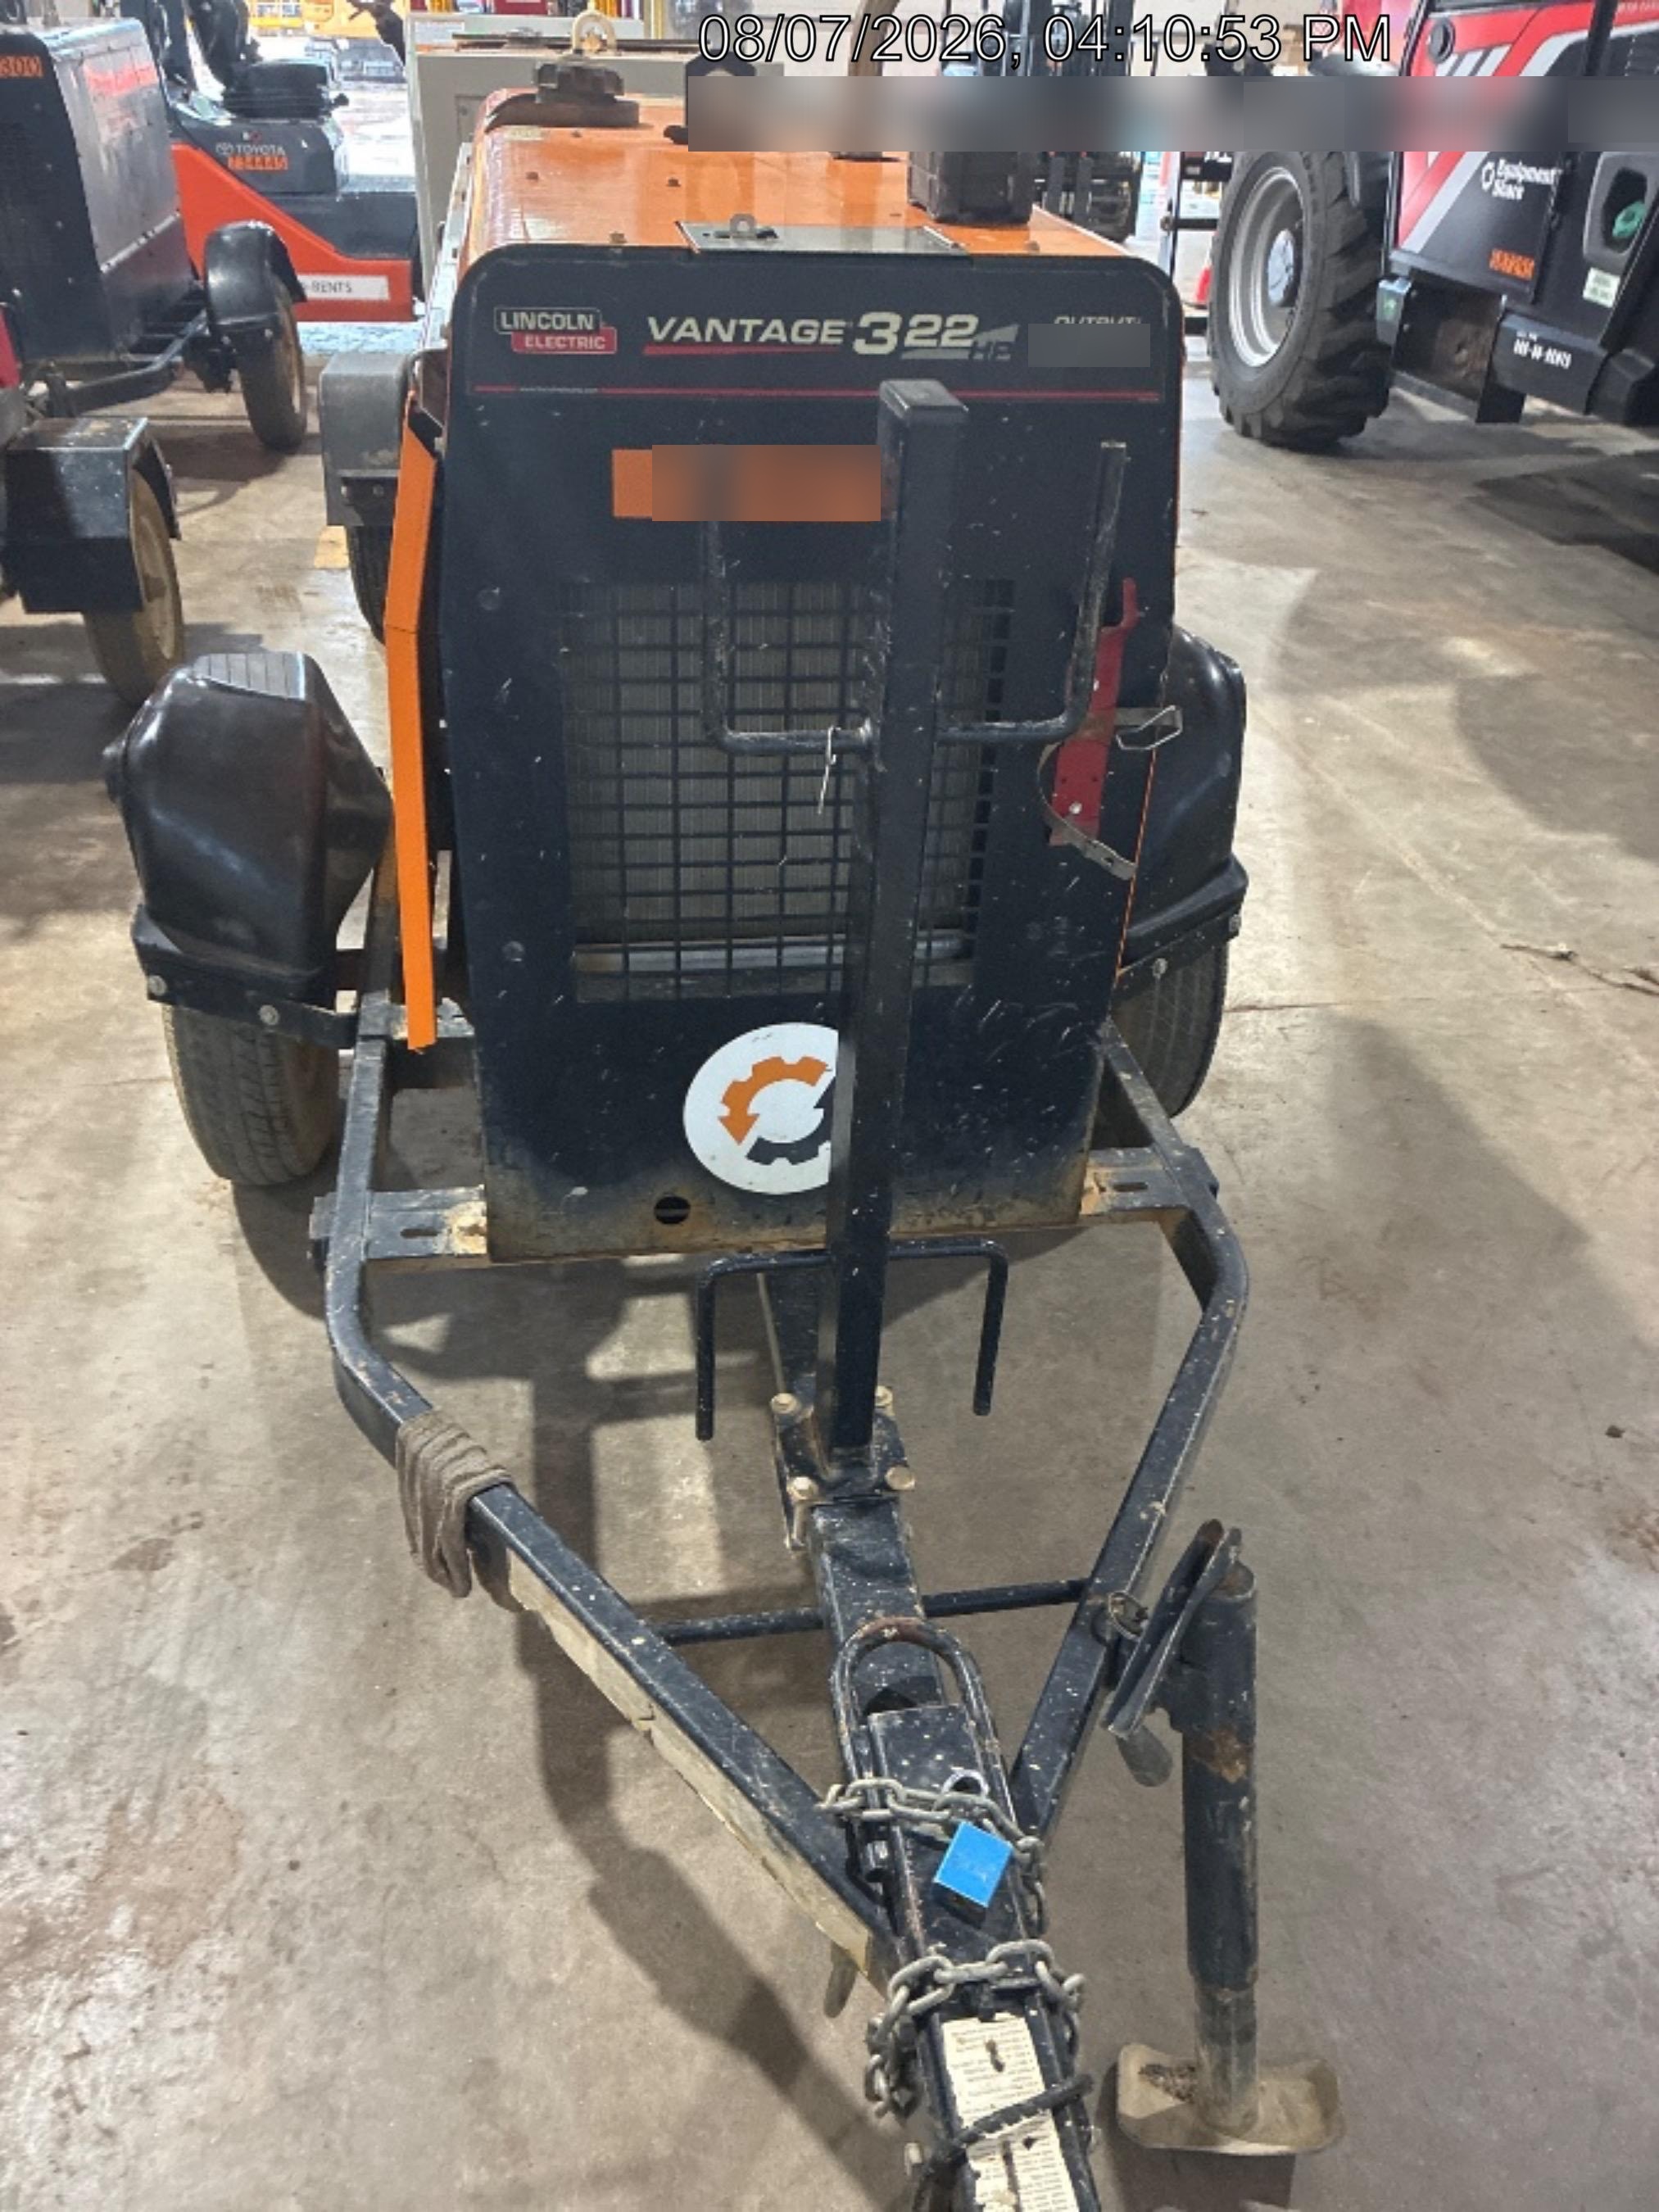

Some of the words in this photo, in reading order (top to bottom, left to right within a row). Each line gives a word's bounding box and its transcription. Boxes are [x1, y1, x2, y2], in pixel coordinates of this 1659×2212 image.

[236, 143, 286, 156] TOYOTA
[500, 310, 594, 330] LINCOLN
[524, 334, 605, 350] ELECTRIC
[647, 316, 848, 345] VANTAGE
[853, 311, 979, 356] 322
